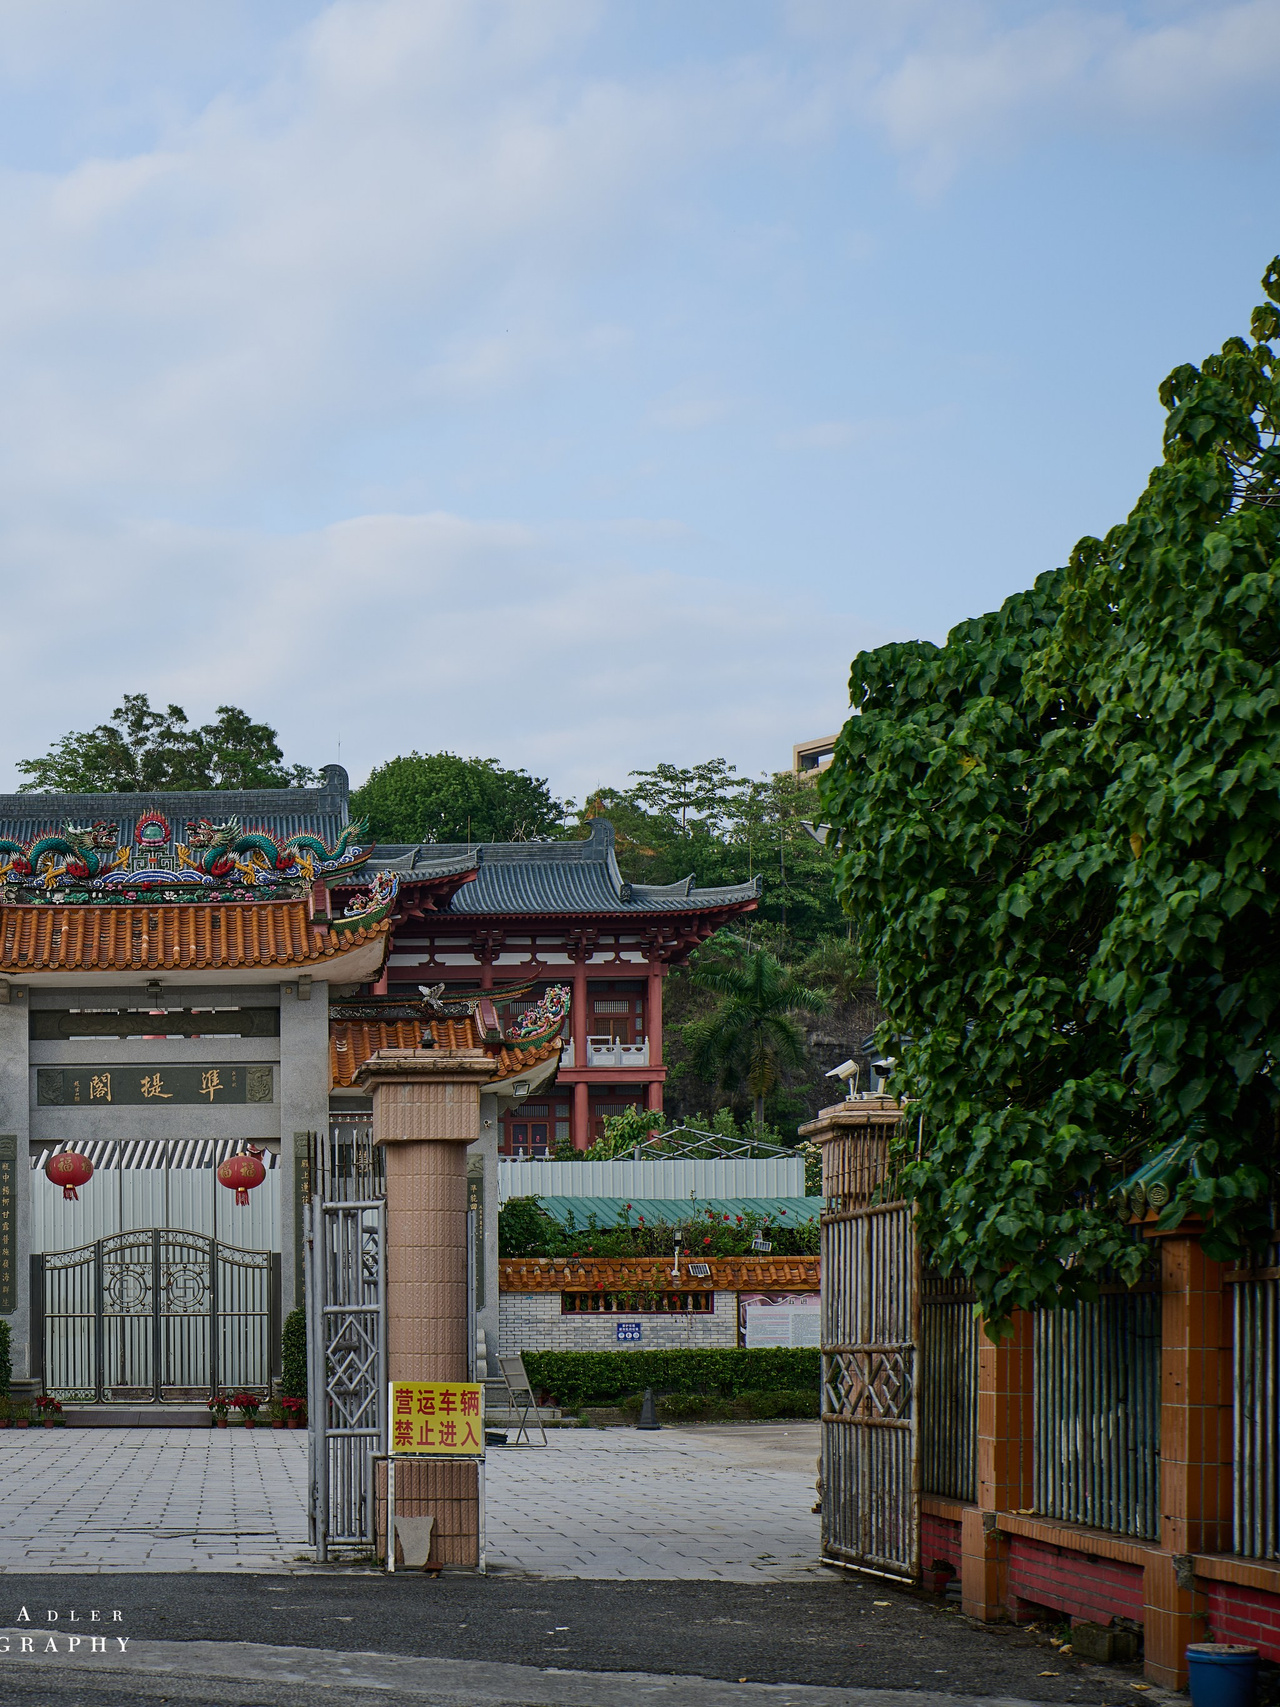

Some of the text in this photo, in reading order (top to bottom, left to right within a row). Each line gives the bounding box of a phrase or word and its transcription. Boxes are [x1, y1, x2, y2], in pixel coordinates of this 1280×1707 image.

[58, 1156, 74, 1173] 福
[240, 1161, 256, 1178] 福
[395, 1388, 480, 1416] 营运车辆
[395, 1419, 480, 1447] 禁止进入
